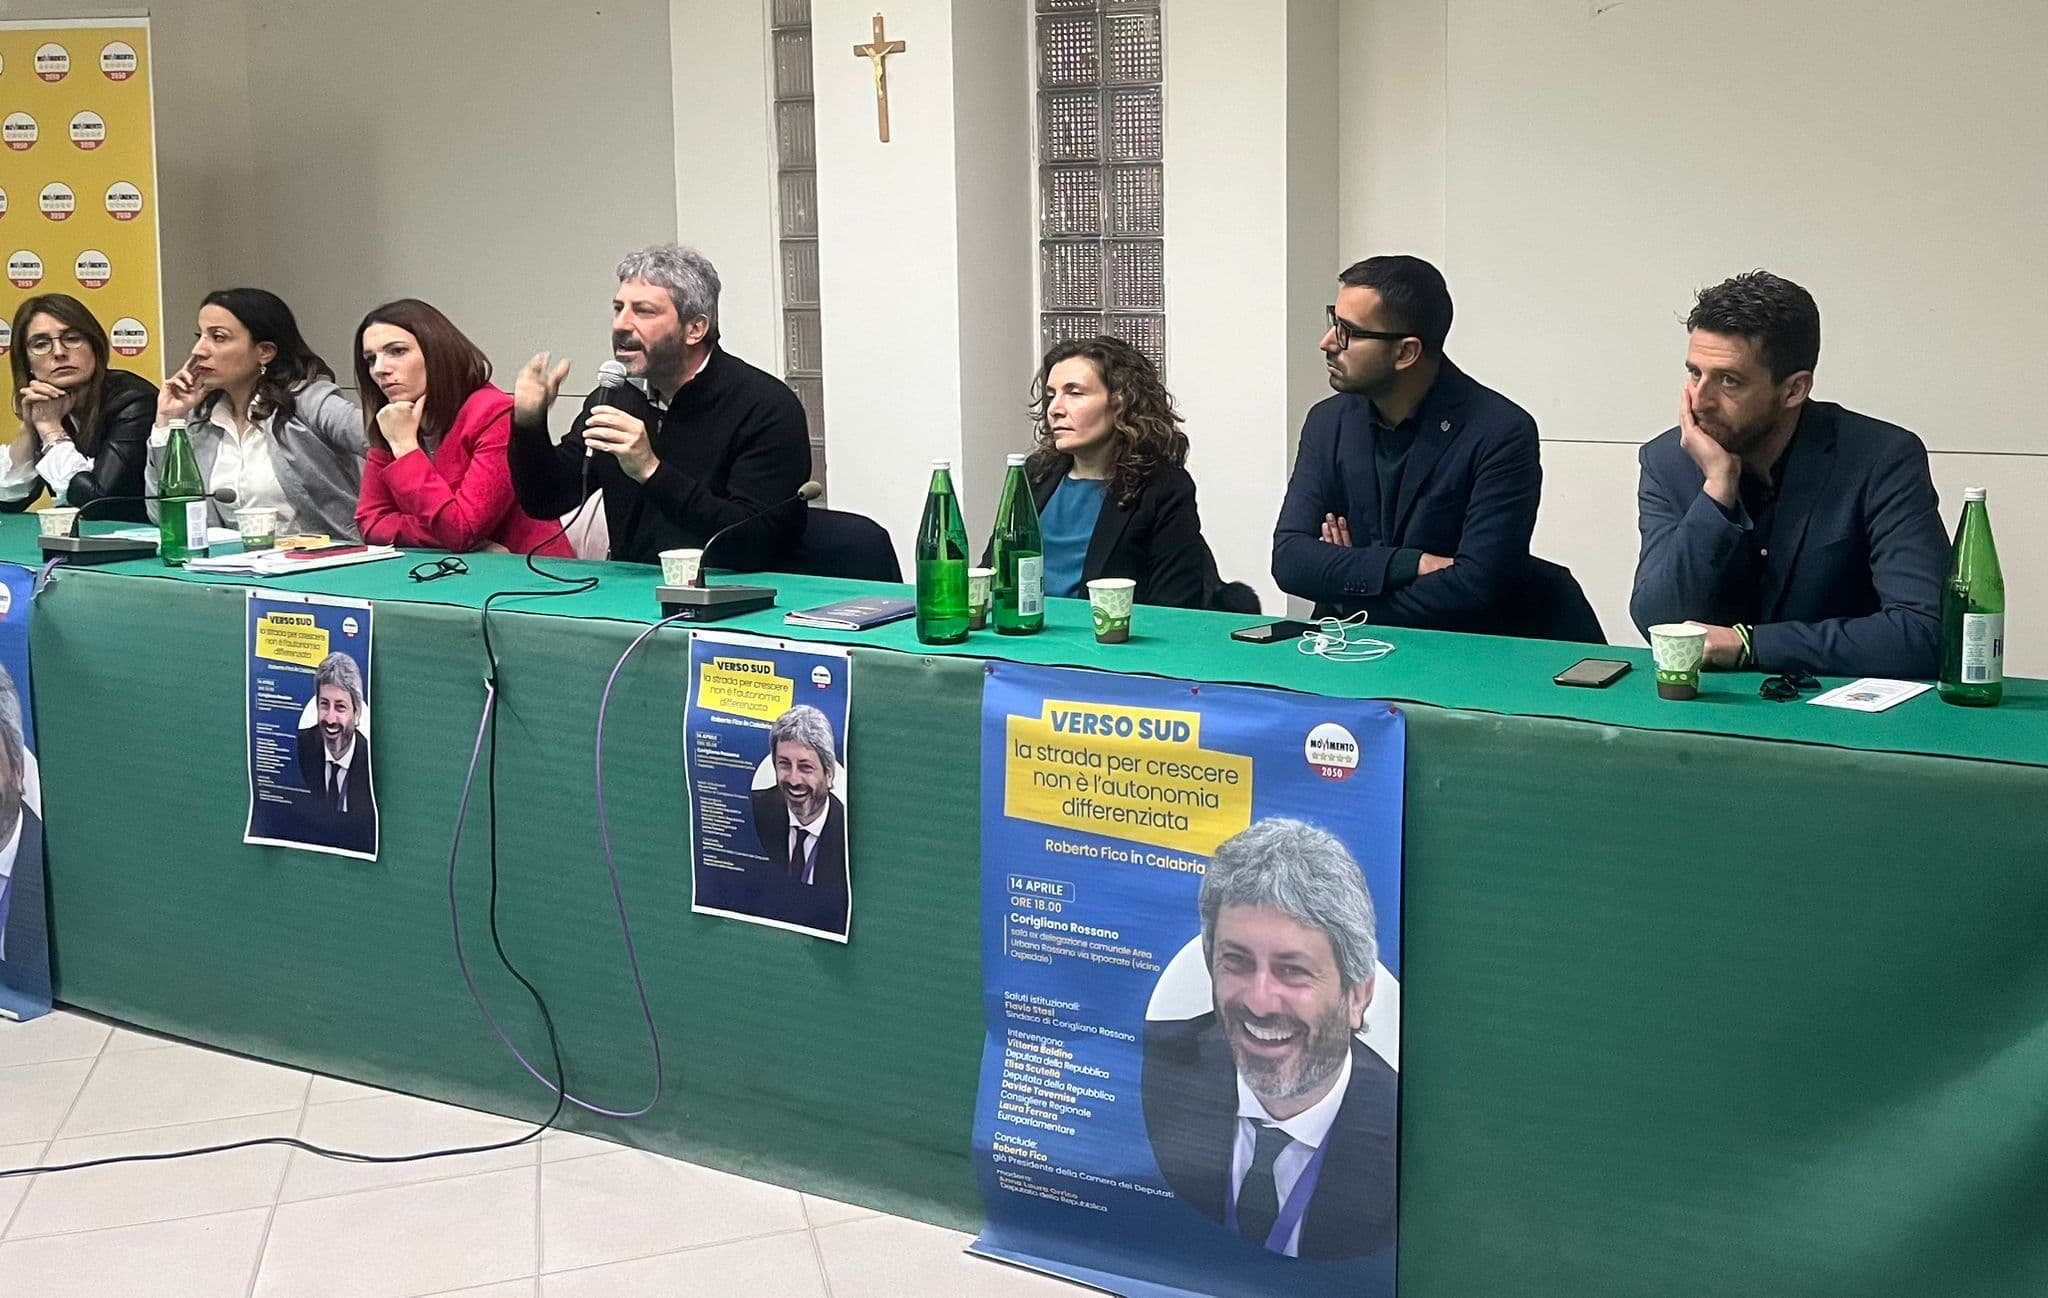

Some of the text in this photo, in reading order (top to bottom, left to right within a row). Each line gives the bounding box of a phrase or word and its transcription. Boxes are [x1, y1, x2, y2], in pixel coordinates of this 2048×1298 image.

[270, 616, 312, 626] VERSO SUD
[717, 660, 770, 674] VERSO SUD
[1051, 710, 1191, 743] VERSO SUD
[1310, 737, 1354, 753] MOVIMENTO
[1014, 738, 1238, 786] la strada per crescere
[1321, 766, 1343, 778] 2050
[1033, 771, 1220, 810] non è l'autonomia
[1062, 798, 1190, 832] differenziata
[1046, 838, 1205, 876] Roberto Fico in Calabria
[1010, 877, 1063, 896] 14 APRILE
[1010, 896, 1062, 913] ORE 18.00
[1010, 912, 1119, 940] Corigliano Rossano
[1010, 928, 1028, 938] sala
[1040, 932, 1088, 948] delegazione
[1089, 941, 1131, 956] comunale
[1132, 948, 1152, 960] Area
[1010, 938, 1040, 951] Urbana
[1042, 944, 1076, 958] Rossano
[1078, 950, 1089, 960] via
[1090, 953, 1131, 967] Ippocrate
[1010, 950, 1052, 966] Ospedale)
[1004, 991, 1029, 1003] Saluti
[1005, 1001, 1055, 1017] Flavio Stasi
[1006, 1011, 1136, 1042] Sindaco di Corigliano Rossano
[1007, 1038, 1073, 1060] Vittoria Baldino
[1004, 1059, 1024, 1072] Elisa
[1006, 1048, 1110, 1079] Deputata della Repubblica
[1002, 1080, 1076, 1103] Davide Tavernise
[1003, 1070, 1115, 1102] Deputata della Repubblica
[999, 1100, 1058, 1121] Laura Ferrara
[1000, 1089, 1092, 1118] Consigliere Regionale
[997, 1111, 1076, 1135] Europarlamentare
[993, 1142, 1048, 1162] Roberto Fico
[994, 1132, 1038, 1149] Conclude:
[993, 1153, 1174, 1198] già Presidente della Camera dei Deputati
